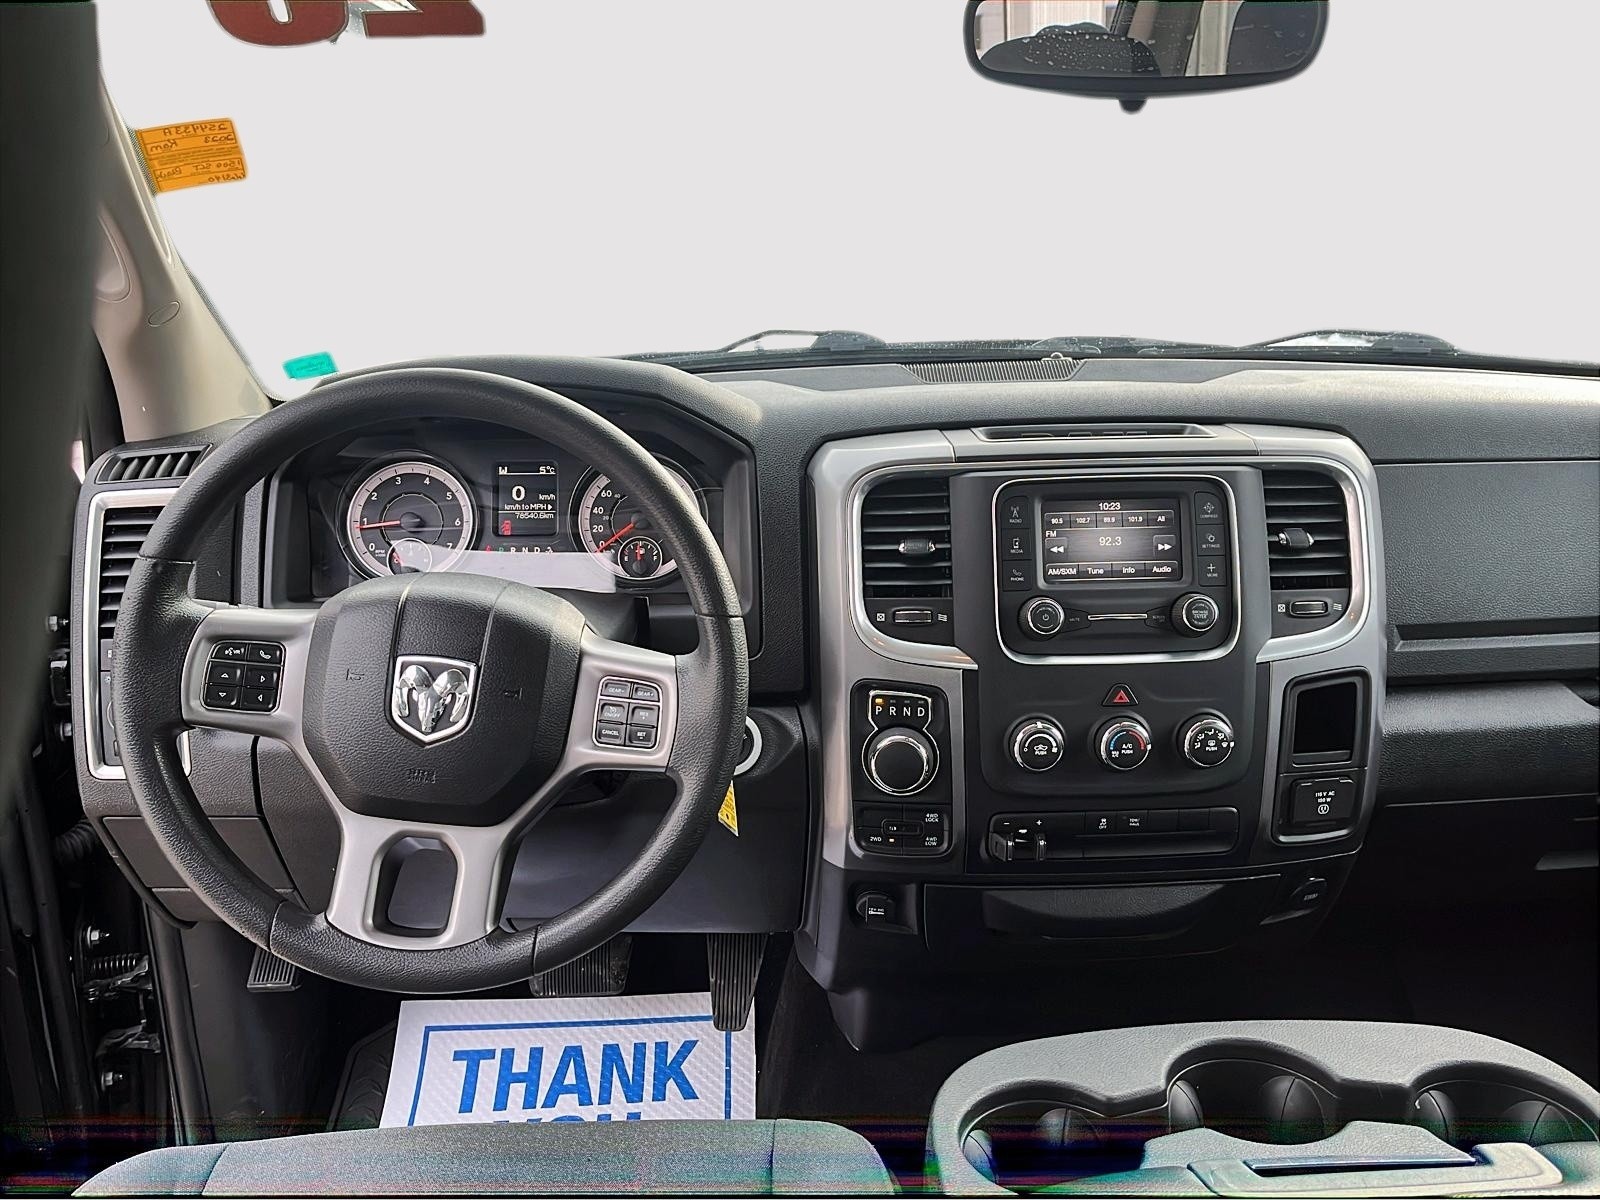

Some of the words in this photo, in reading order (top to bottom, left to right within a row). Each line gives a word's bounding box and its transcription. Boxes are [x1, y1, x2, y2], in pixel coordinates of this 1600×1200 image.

[395, 477, 402, 485] 3
[423, 477, 431, 485] 4
[370, 492, 378, 500] 2
[446, 492, 453, 500] 5
[511, 485, 526, 501] 0
[600, 489, 612, 498] 60
[592, 506, 604, 515] 40
[1098, 502, 1121, 511] 10:23
[454, 518, 461, 526] 6
[592, 525, 604, 533] 20
[1099, 536, 1122, 546] 92.3
[368, 543, 375, 551] 0
[1152, 565, 1172, 573] Audio
[875, 705, 883, 715] P
[889, 706, 897, 716] R
[903, 706, 911, 717] N
[917, 707, 925, 717] D
[452, 1039, 700, 1114] THANK
